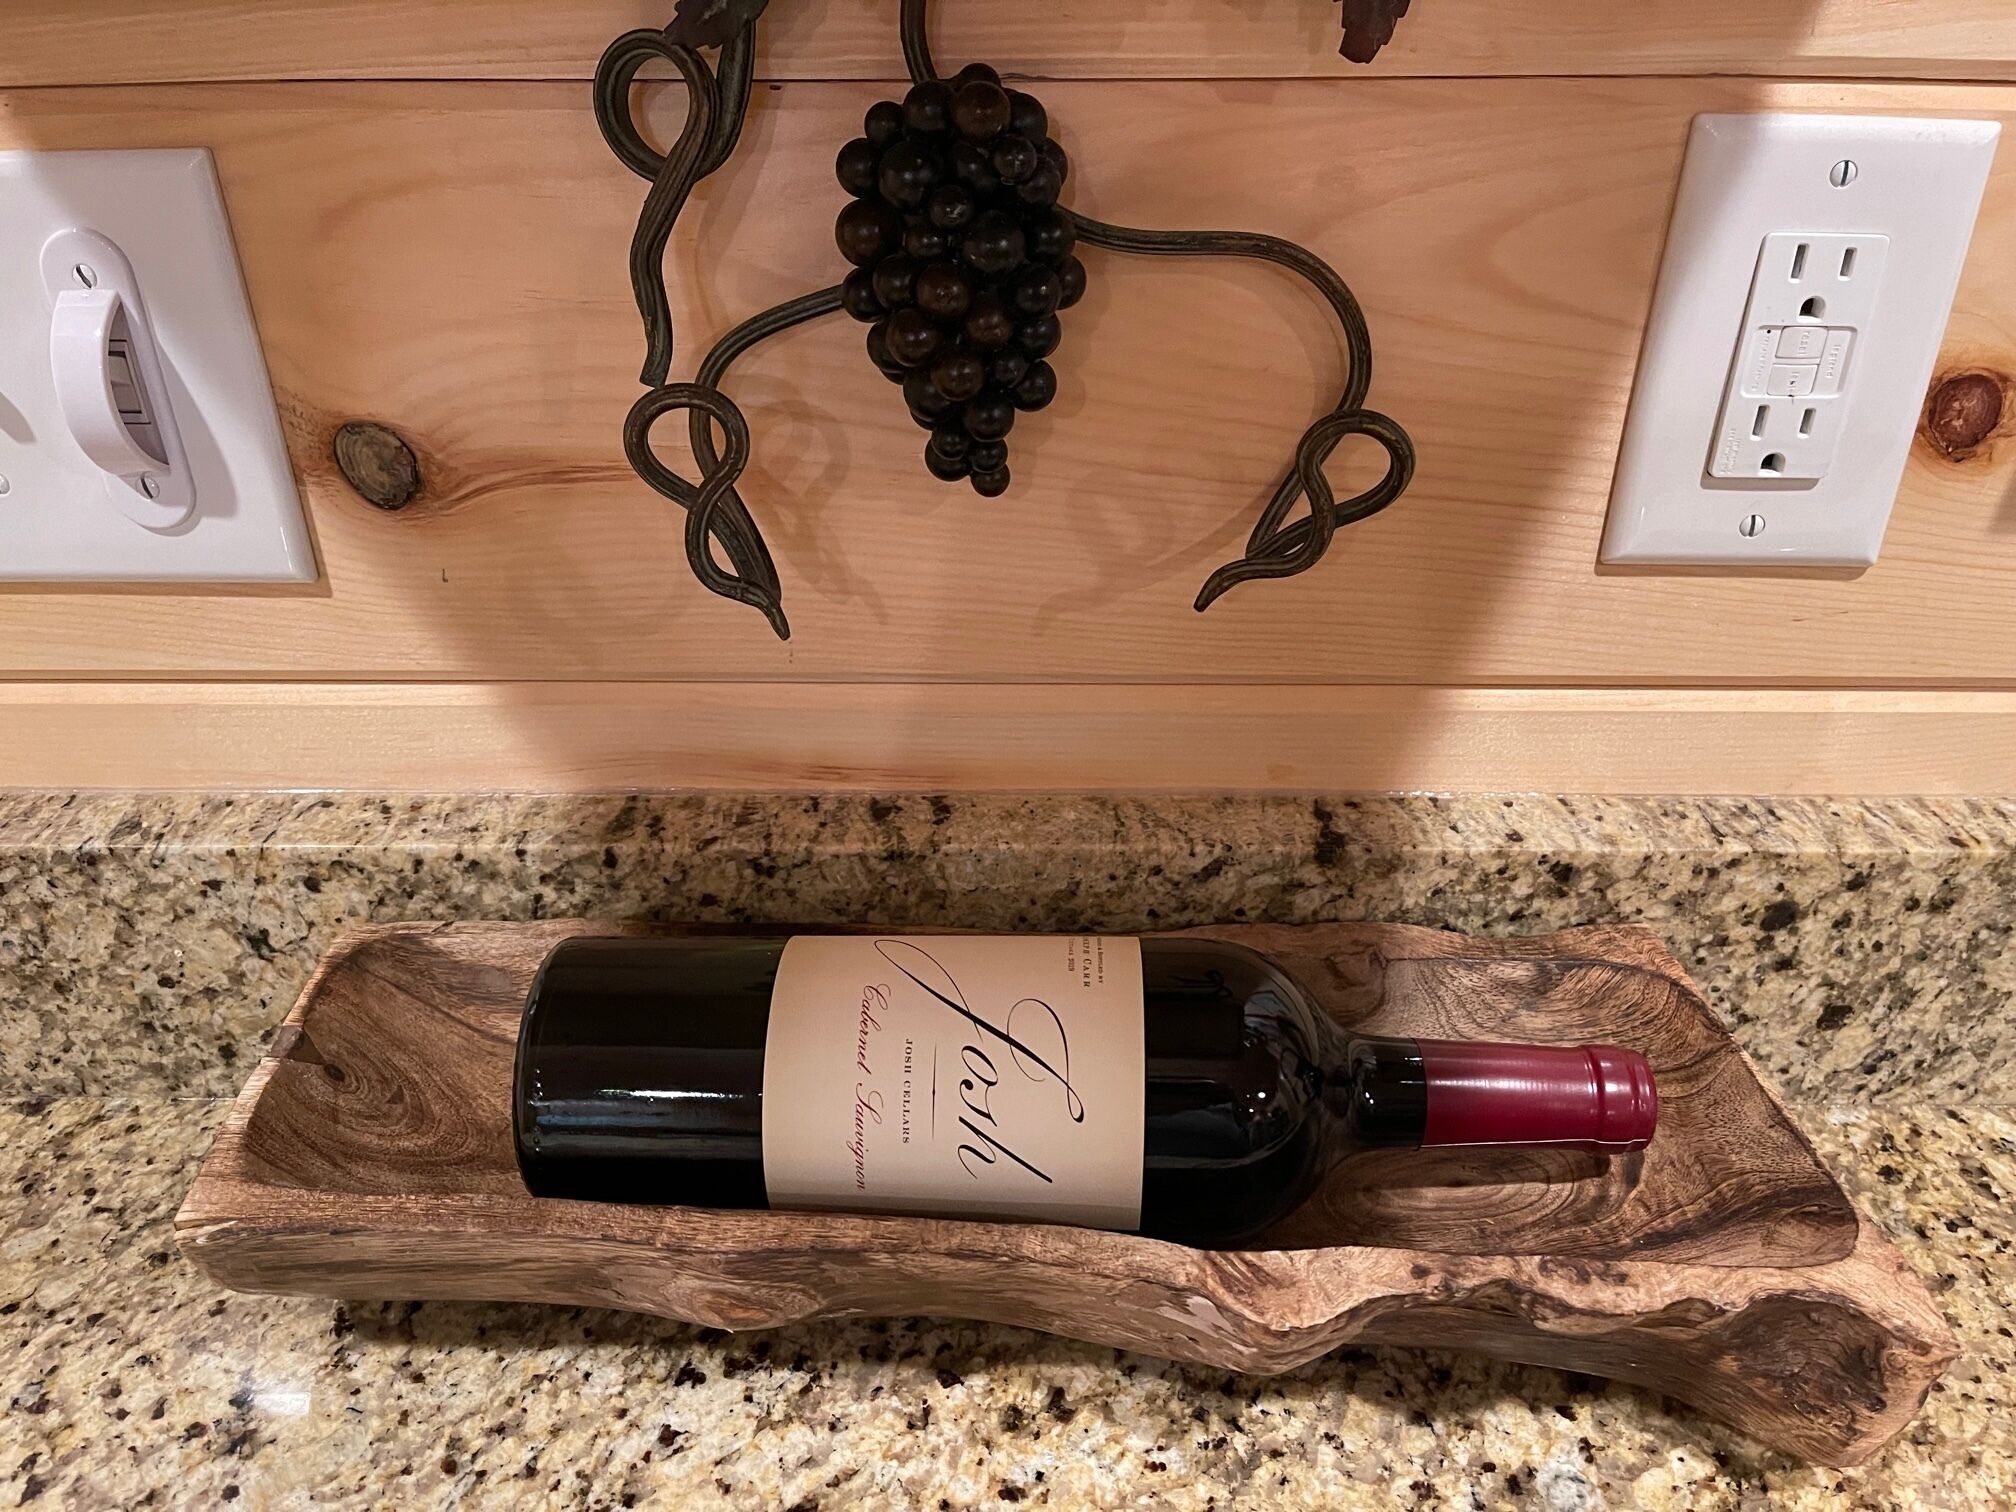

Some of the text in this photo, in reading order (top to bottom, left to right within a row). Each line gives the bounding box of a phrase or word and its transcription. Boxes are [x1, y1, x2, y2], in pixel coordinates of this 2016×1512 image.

[847, 983, 891, 1191] Cabernet Sauvignon
[874, 940, 1084, 1183] Josh
[902, 1038, 913, 1144] JOSH CELLARS
